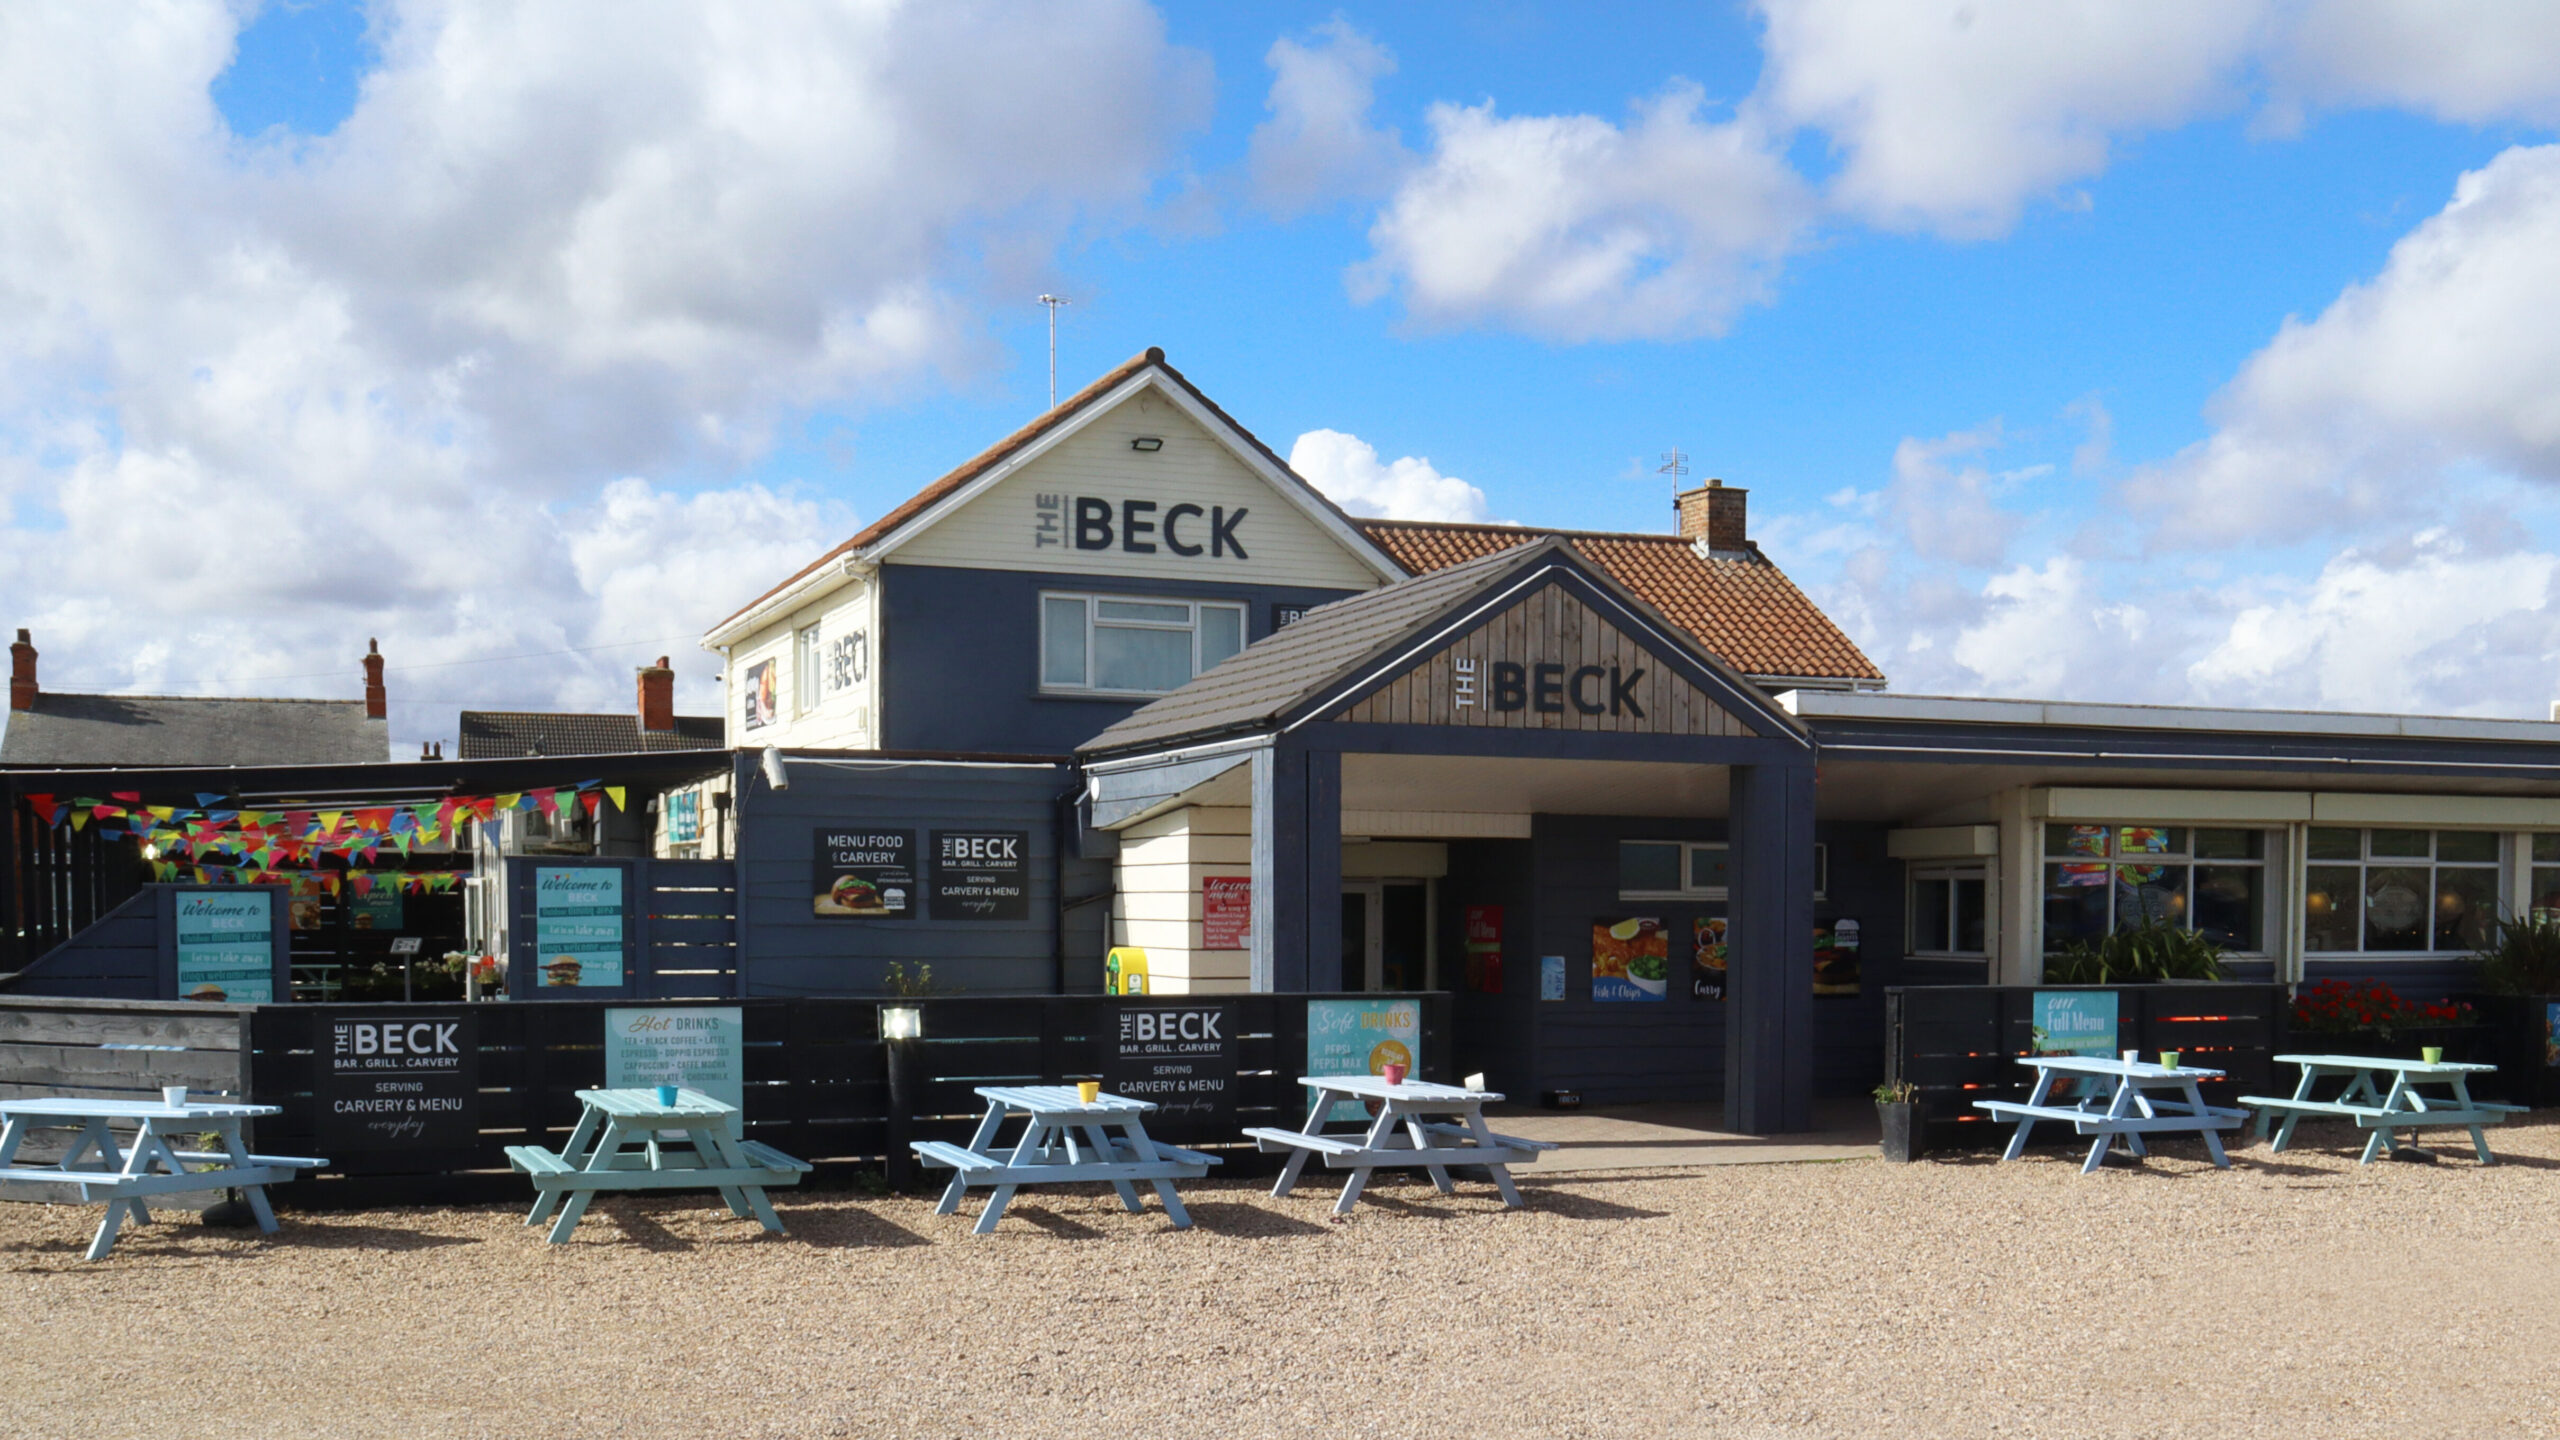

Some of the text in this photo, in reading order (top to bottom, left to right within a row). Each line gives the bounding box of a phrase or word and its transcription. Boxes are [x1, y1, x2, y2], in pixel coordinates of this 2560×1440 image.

[1036, 493, 1249, 559] THE BECK
[1456, 658, 1646, 718] THE BECK
[828, 835, 903, 847] MENU FOOD
[942, 838, 1018, 859] THE BECK
[840, 852, 896, 863] CARVERY
[985, 860, 1017, 868] CARVERY
[542, 879, 613, 890] Welcome to
[568, 892, 598, 902] BECK
[942, 887, 1019, 896] CARVERY & MENU
[182, 903, 260, 916] Welcome to
[211, 918, 245, 929] BECK
[1593, 985, 1609, 998] Fish
[1618, 984, 1641, 1000] Chips
[1694, 979, 1721, 999] Curry
[2048, 997, 2077, 1010] our
[628, 1014, 720, 1032] Hot DRINKS
[1120, 1012, 1222, 1040] THE BECK
[1317, 1006, 1411, 1034] Soft DRINKS
[2047, 1011, 2104, 1031] Full Menu
[334, 1023, 459, 1054] THE BECK
[624, 1035, 726, 1046] TEA BLACK COFFEE LATTE
[621, 1048, 658, 1058] ESPRESSO
[693, 1047, 730, 1057] ESPRESSO
[1120, 1043, 1222, 1053] BAR GRILL CARVERY
[1324, 1043, 1351, 1055] PEPSI
[334, 1057, 459, 1068] BAR GRILL CARVERY
[624, 1060, 669, 1070] CAPPUCCINO
[701, 1059, 726, 1069] MOCHA
[1313, 1057, 1361, 1069] PEPSI MAX
[1153, 1065, 1192, 1075] SERVING
[639, 1072, 679, 1082] CHOCOLATE
[376, 1082, 423, 1092] SERVING
[1119, 1079, 1224, 1093] CARVERY & MENU
[334, 1098, 462, 1113] CARVERY & MENU
[368, 1115, 425, 1138] everyday
